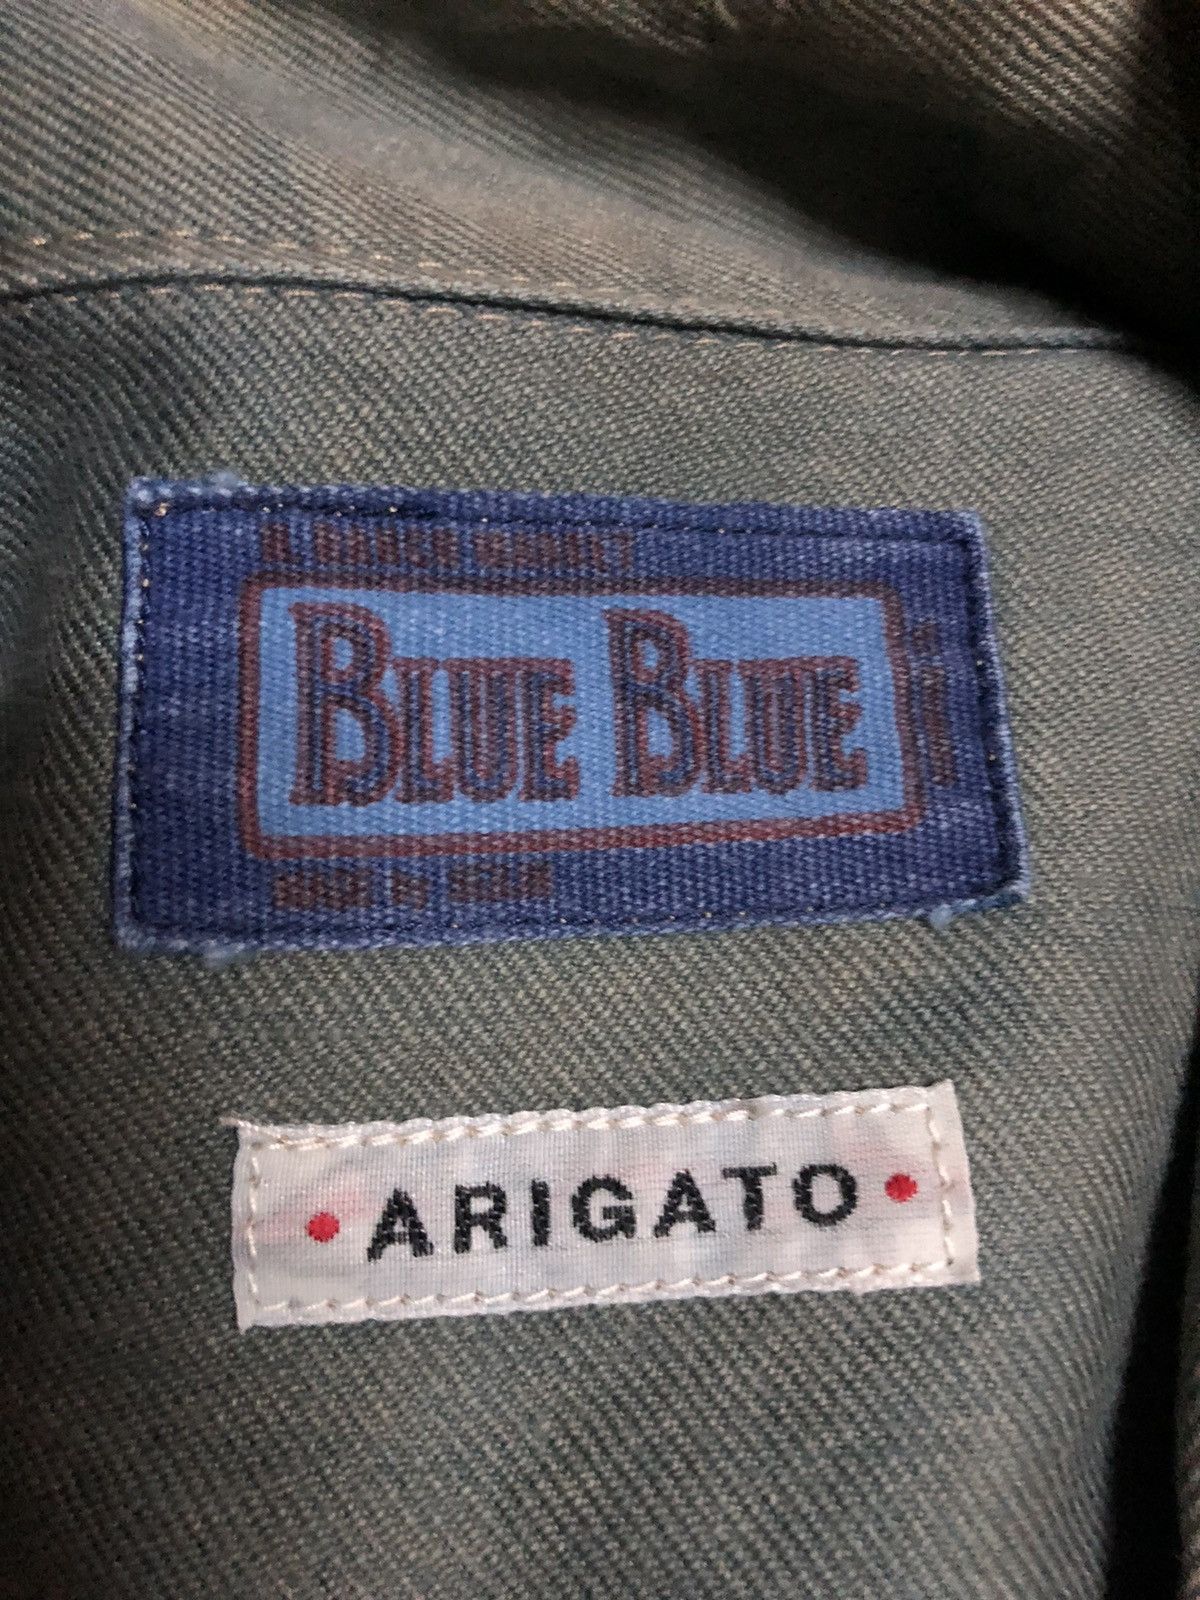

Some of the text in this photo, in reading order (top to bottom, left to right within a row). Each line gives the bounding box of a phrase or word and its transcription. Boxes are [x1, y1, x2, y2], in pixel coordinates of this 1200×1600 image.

[289, 602, 580, 808] BLUE
[604, 608, 869, 799] BLUE
[366, 1161, 859, 1263] ARIGATO
